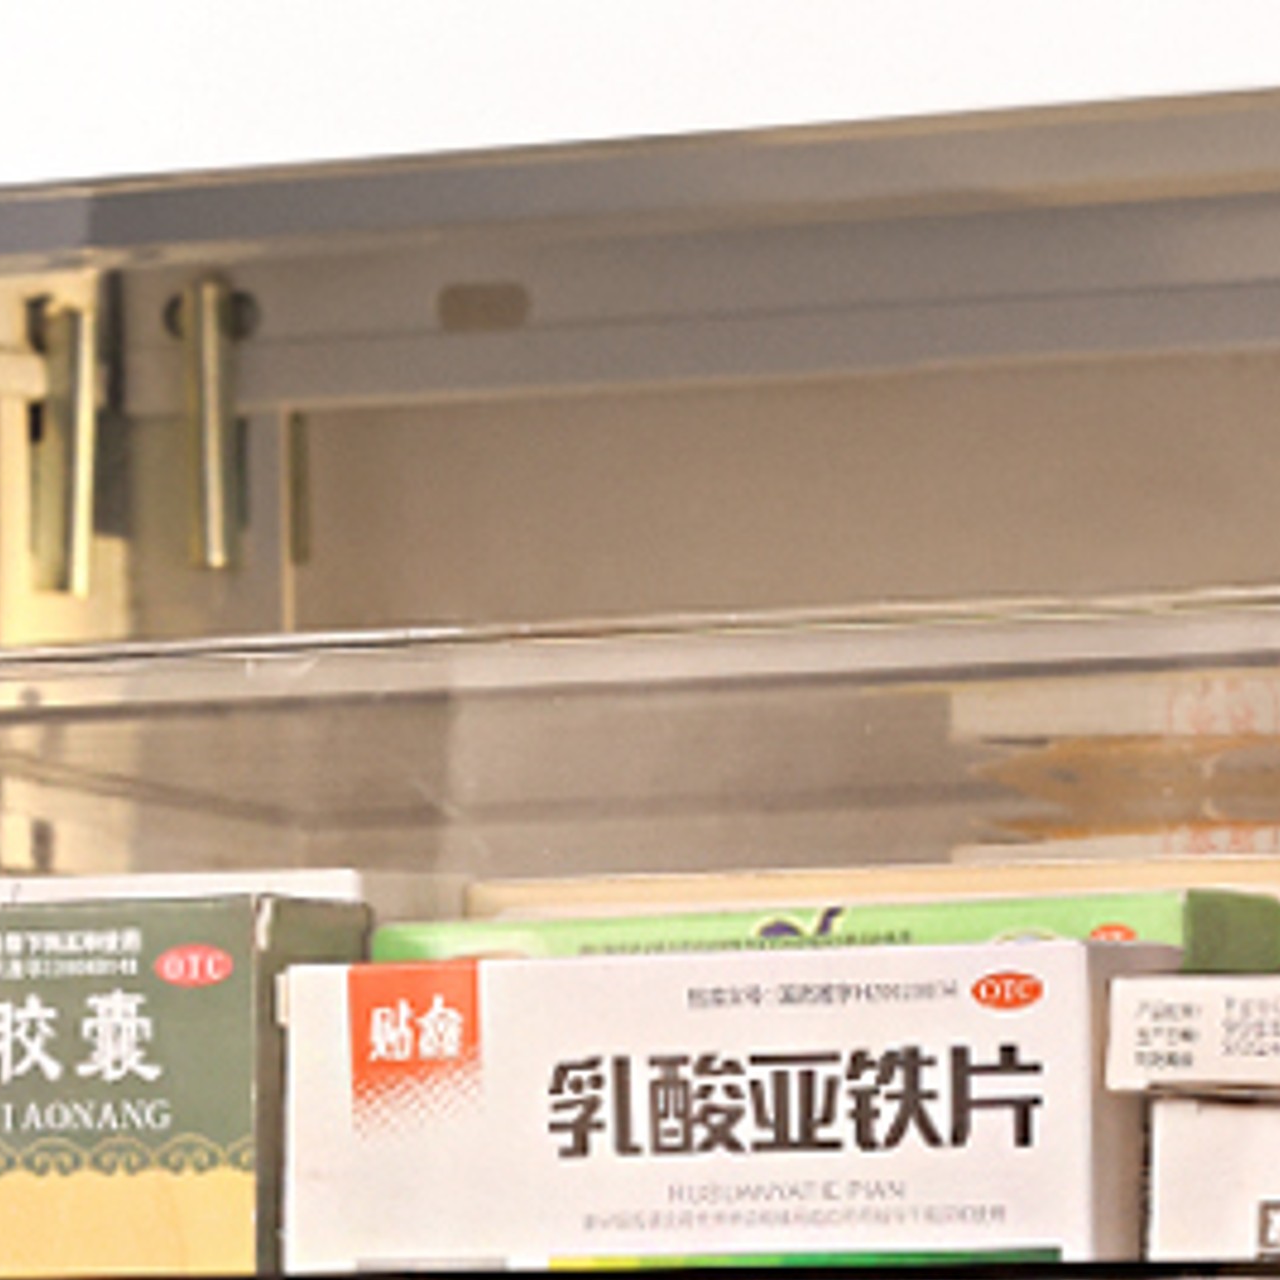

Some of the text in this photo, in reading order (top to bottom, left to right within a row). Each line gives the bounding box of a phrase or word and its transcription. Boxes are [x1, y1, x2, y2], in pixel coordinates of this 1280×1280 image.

[160, 949, 227, 985] OTC
[976, 976, 1039, 1004] OTC
[547, 1044, 1043, 1159] 乳酸亚铁片
